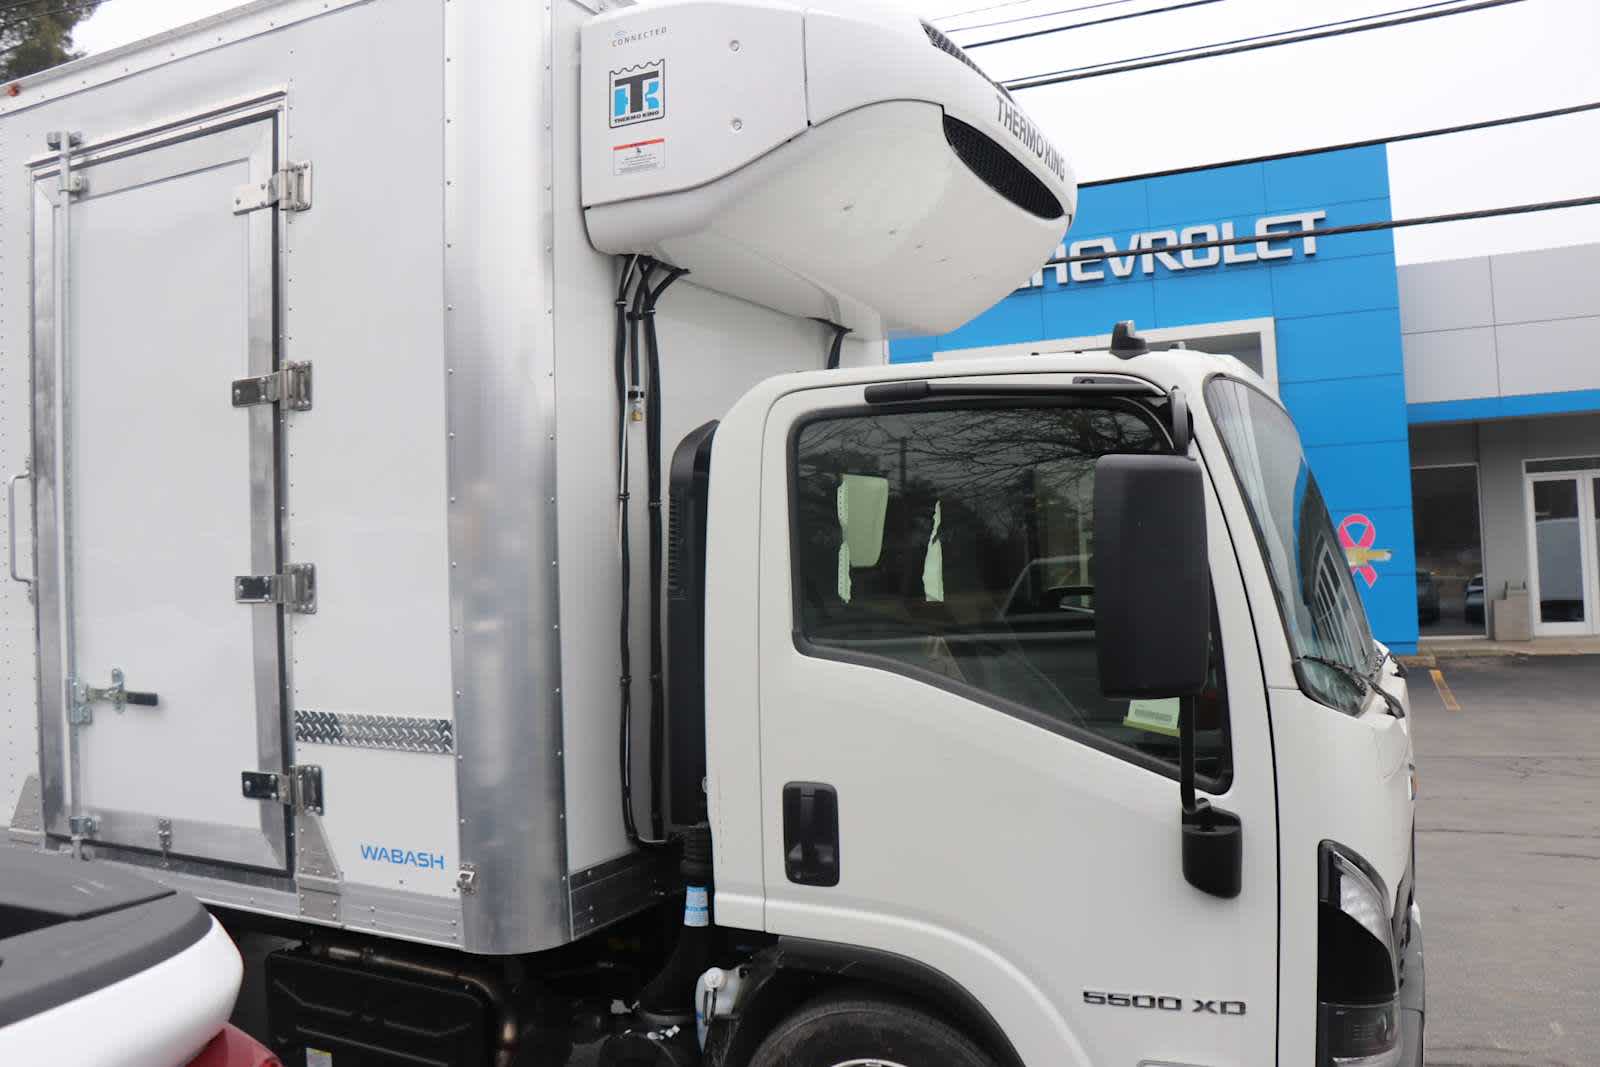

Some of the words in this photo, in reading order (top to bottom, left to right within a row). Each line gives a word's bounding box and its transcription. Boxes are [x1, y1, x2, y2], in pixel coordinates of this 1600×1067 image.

[612, 26, 667, 47] CONNECTED
[614, 113, 641, 123] THERMO
[642, 110, 660, 118] KING
[996, 95, 1043, 158] THERMO
[1044, 141, 1065, 181] KING
[1020, 210, 1326, 288] HEVROLET
[360, 844, 444, 869] WABASH
[1083, 991, 1182, 1011] 5500
[1192, 1000, 1246, 1016] XD
